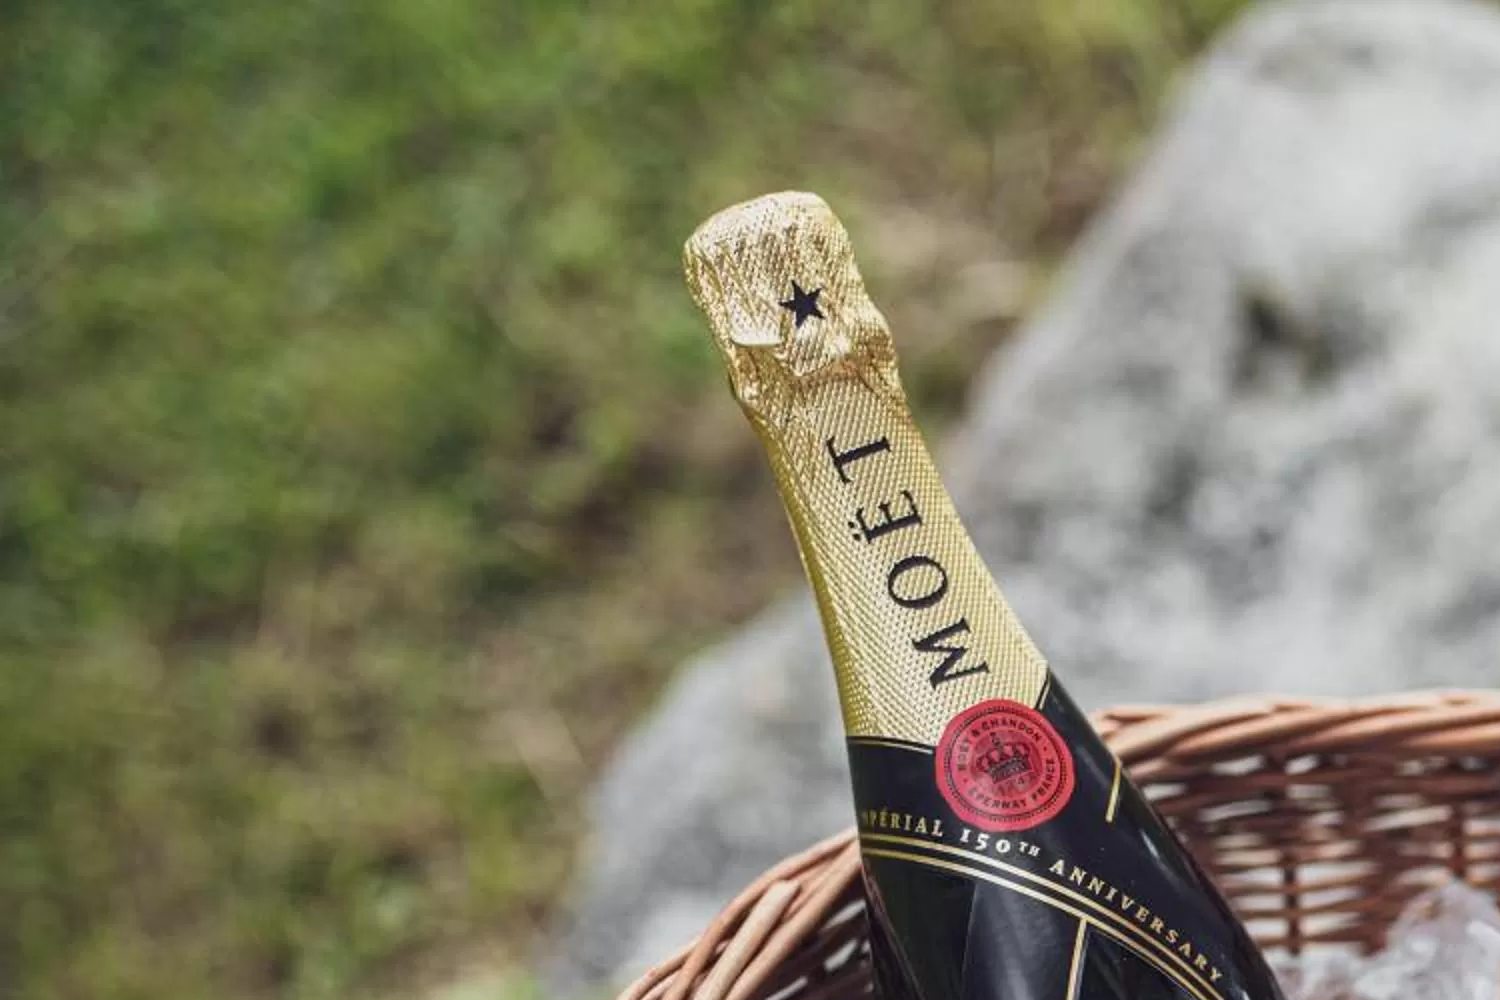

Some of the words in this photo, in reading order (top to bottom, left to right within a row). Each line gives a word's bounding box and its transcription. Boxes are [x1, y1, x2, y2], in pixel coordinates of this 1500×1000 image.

[826, 434, 990, 691] MOËT
[861, 807, 944, 838] PÉRIAL
[1049, 858, 1223, 983] ANNIVERSARY
